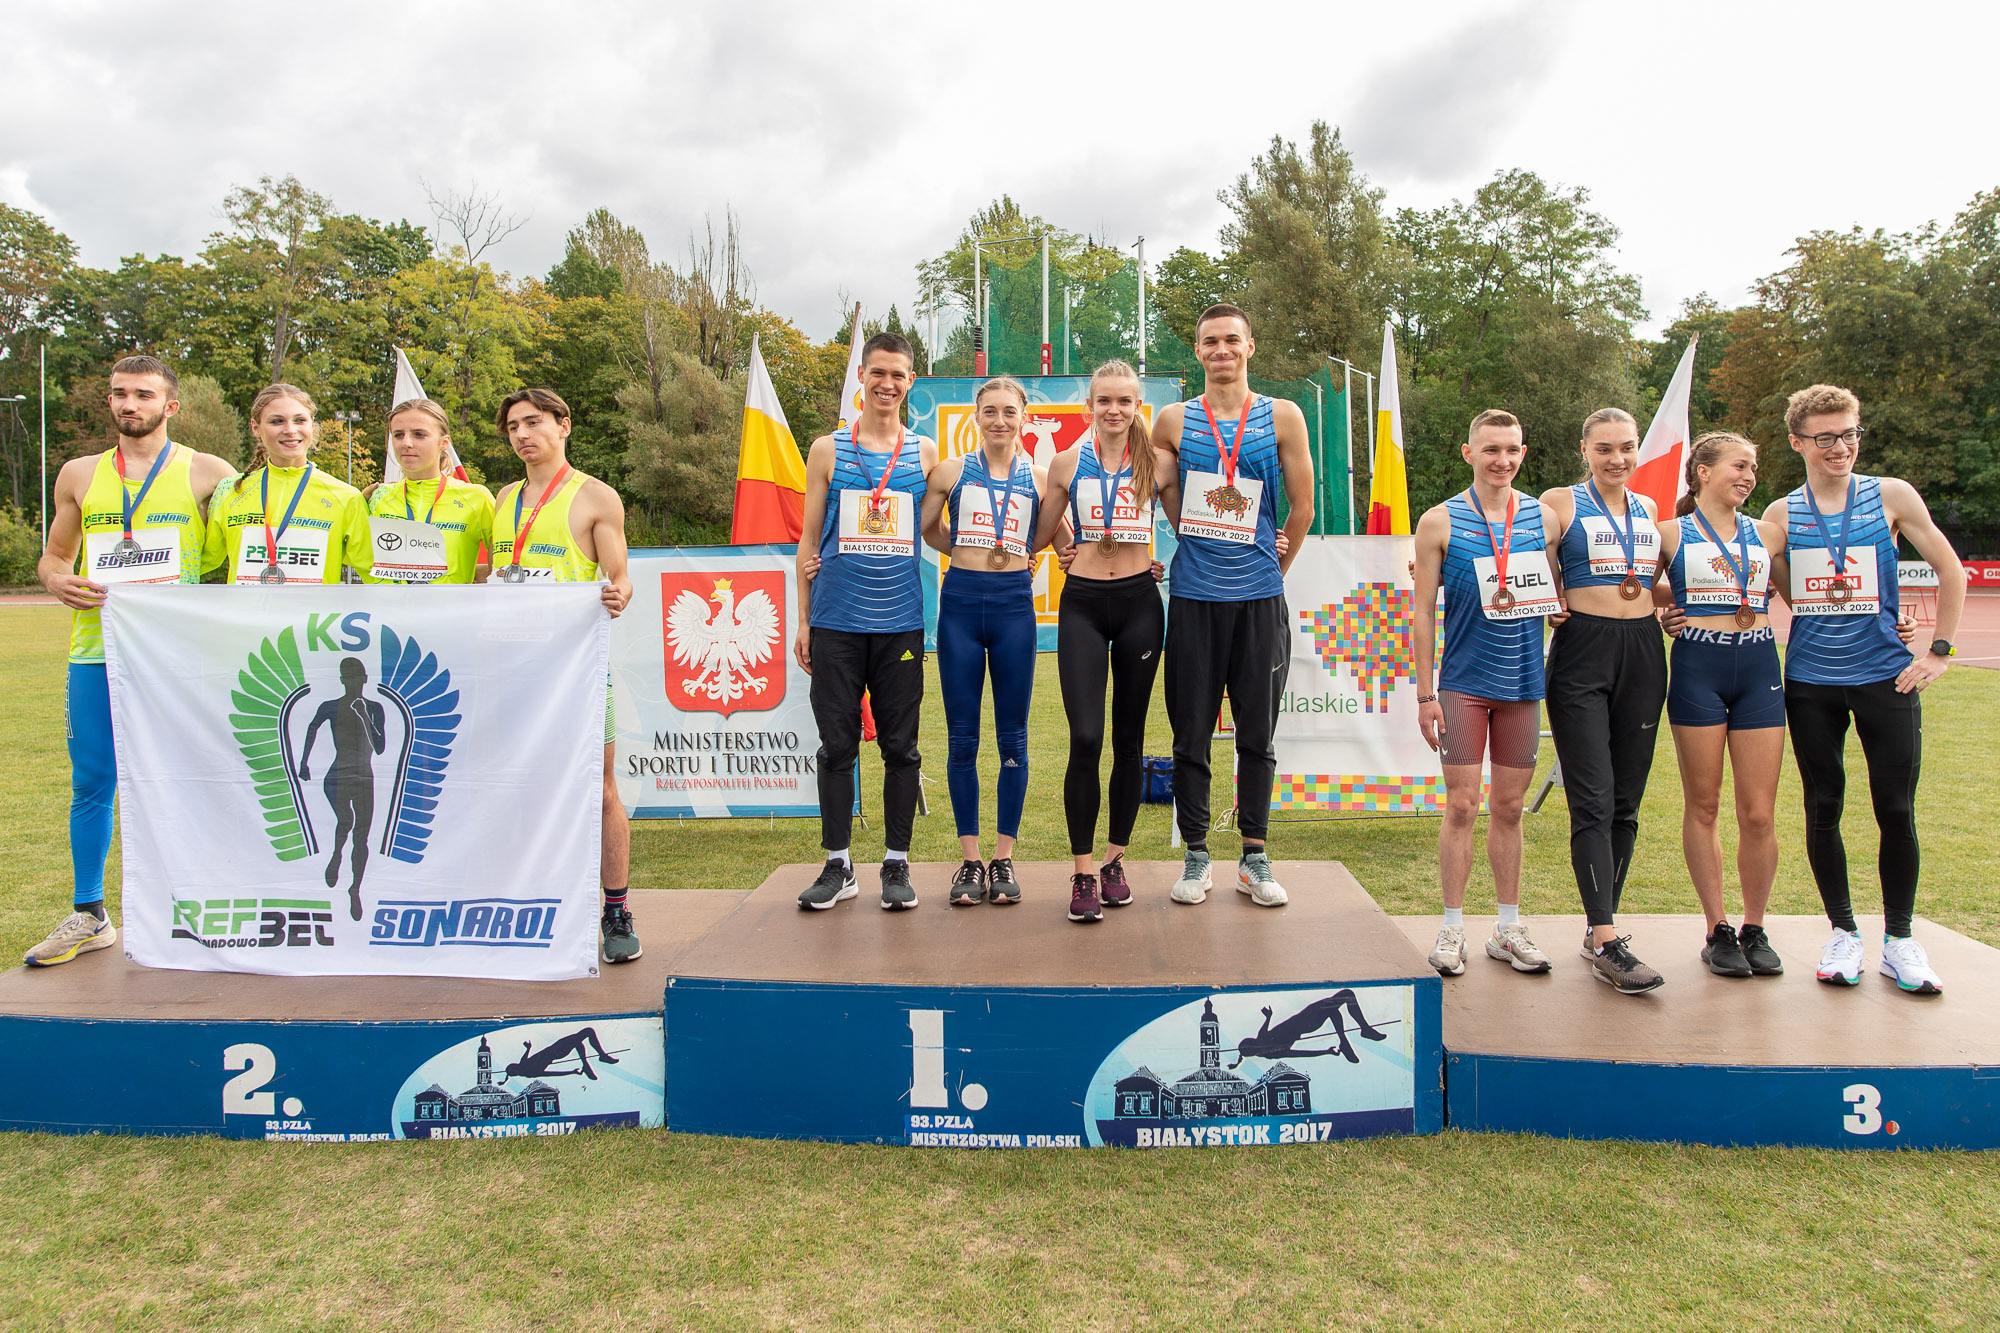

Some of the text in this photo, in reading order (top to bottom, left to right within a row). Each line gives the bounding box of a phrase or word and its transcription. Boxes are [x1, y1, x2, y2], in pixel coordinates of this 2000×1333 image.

[146, 512, 193, 526] SONAROL
[1093, 507, 1137, 518] OLEN
[1186, 508, 1215, 518] Podlaskie
[289, 516, 334, 531] SONAROL
[974, 513, 1017, 531] ORN
[1085, 531, 1125, 540] BIAŁYOK
[1183, 525, 1250, 542] BIAŁYSTOK 2022
[409, 539, 440, 549] Okęcie
[528, 543, 569, 558] SONAROL
[843, 544, 910, 554] BIAŁYSTOK 2022
[960, 537, 996, 547] BIAŁYSTO
[1004, 543, 1022, 553] 2022
[246, 545, 320, 566] PRFBET
[374, 569, 419, 579] BIAŁYSTOK
[1595, 565, 1639, 573] BIAŁYSTK
[1898, 568, 1937, 579] PORT
[1692, 577, 1725, 585] Podlaskie
[1691, 594, 1740, 603] BIAŁYSTOK
[1537, 604, 1557, 613] 2022
[1797, 603, 1874, 614] BIAŁYSTOK 2022
[306, 612, 372, 653] KS
[1678, 625, 1775, 646] NIKE PRO
[1278, 691, 1359, 714] dlaskie
[653, 730, 799, 751] MINISTERSTWO
[628, 753, 701, 776] SPORTU
[722, 752, 817, 775] TURYSTYK
[655, 776, 798, 791] RZECZYPOSPOLITEJ POLSKIEJ
[369, 898, 562, 949] SONAROL
[222, 1042, 303, 1117] 2.
[535, 1121, 577, 1137] 2017
[1136, 1121, 1333, 1148] BIAŁYSTOK 2017
[910, 1132, 1082, 1148] MISTRZOSTWA POLSKI
